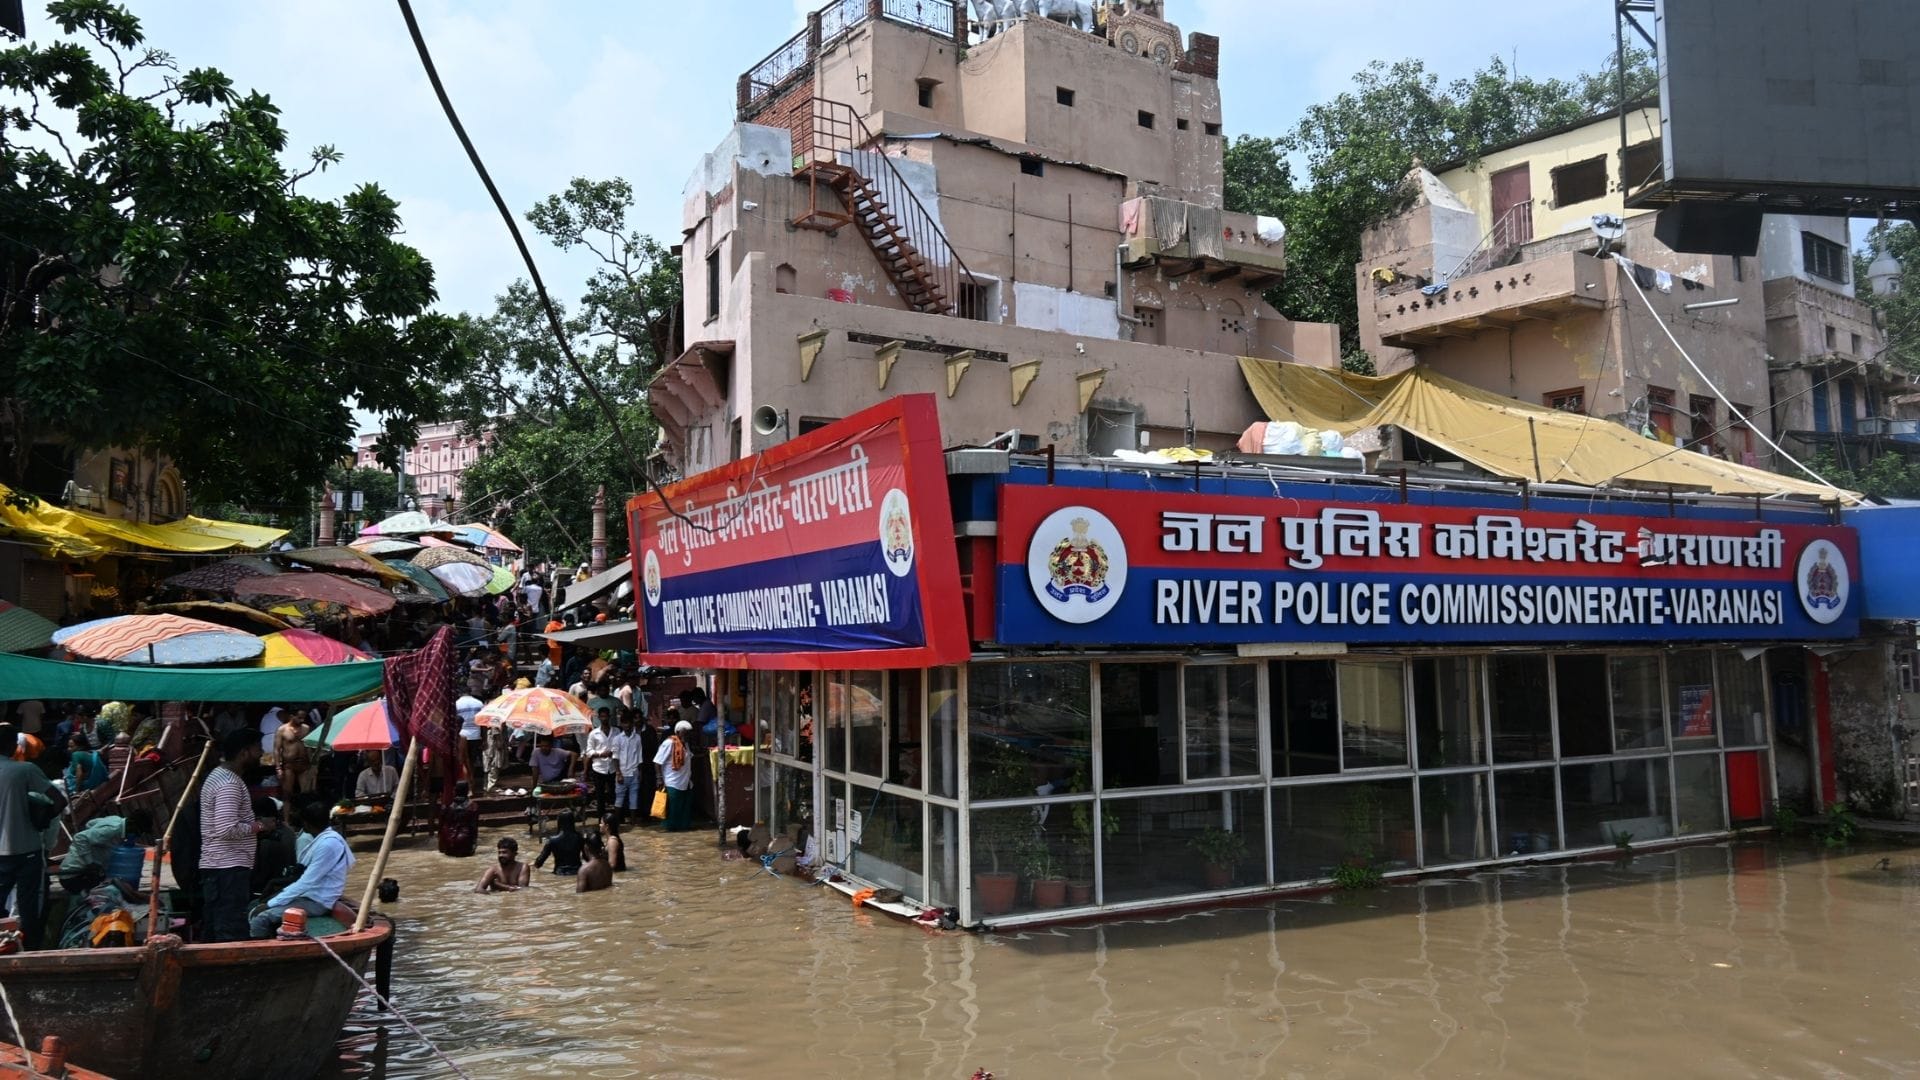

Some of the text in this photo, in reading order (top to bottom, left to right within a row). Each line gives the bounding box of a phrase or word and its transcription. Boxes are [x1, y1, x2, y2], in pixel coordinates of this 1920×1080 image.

[657, 517, 679, 556] जल
[1161, 511, 1265, 553] जल
[1280, 507, 1423, 570] पुलिस
[662, 573, 891, 635] RIVER POLICE COMMISSIONERATE- VARANASI
[1156, 579, 1784, 626] RIVER POLICE COMMISSIONERATE-VARANASI
